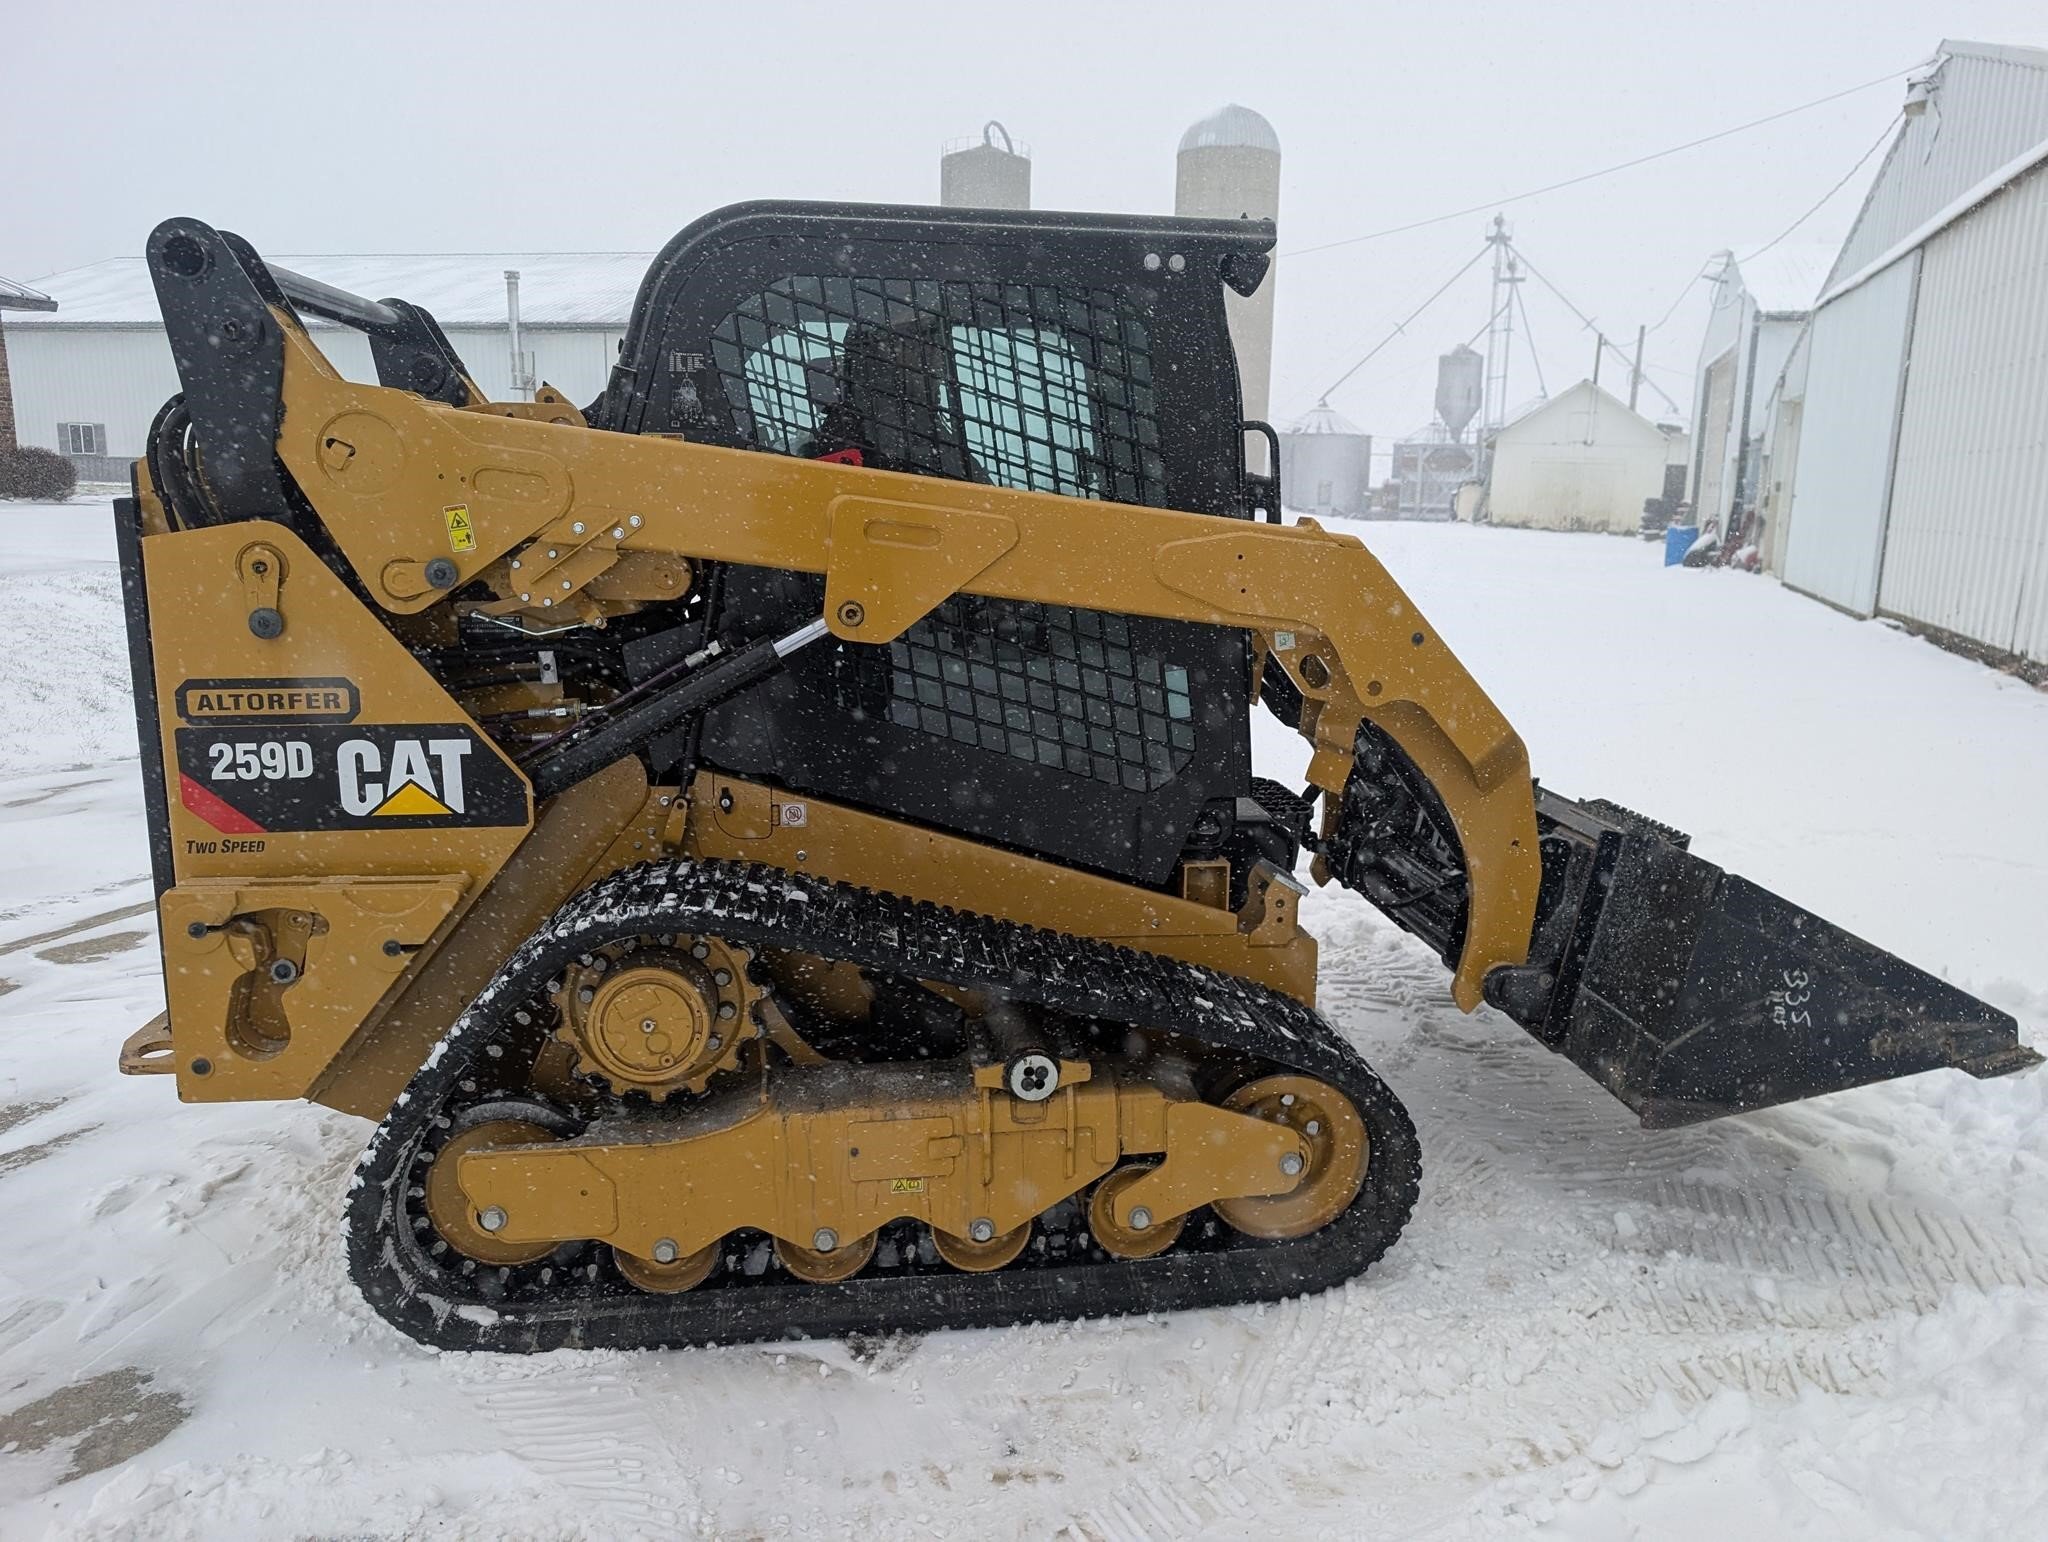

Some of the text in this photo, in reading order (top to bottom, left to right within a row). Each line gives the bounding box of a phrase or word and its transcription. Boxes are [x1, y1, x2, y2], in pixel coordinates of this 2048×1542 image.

[197, 692, 342, 711] ALTORFER
[208, 741, 314, 780] 259D
[336, 738, 472, 817] CAT
[1783, 970, 1811, 1027] 335
